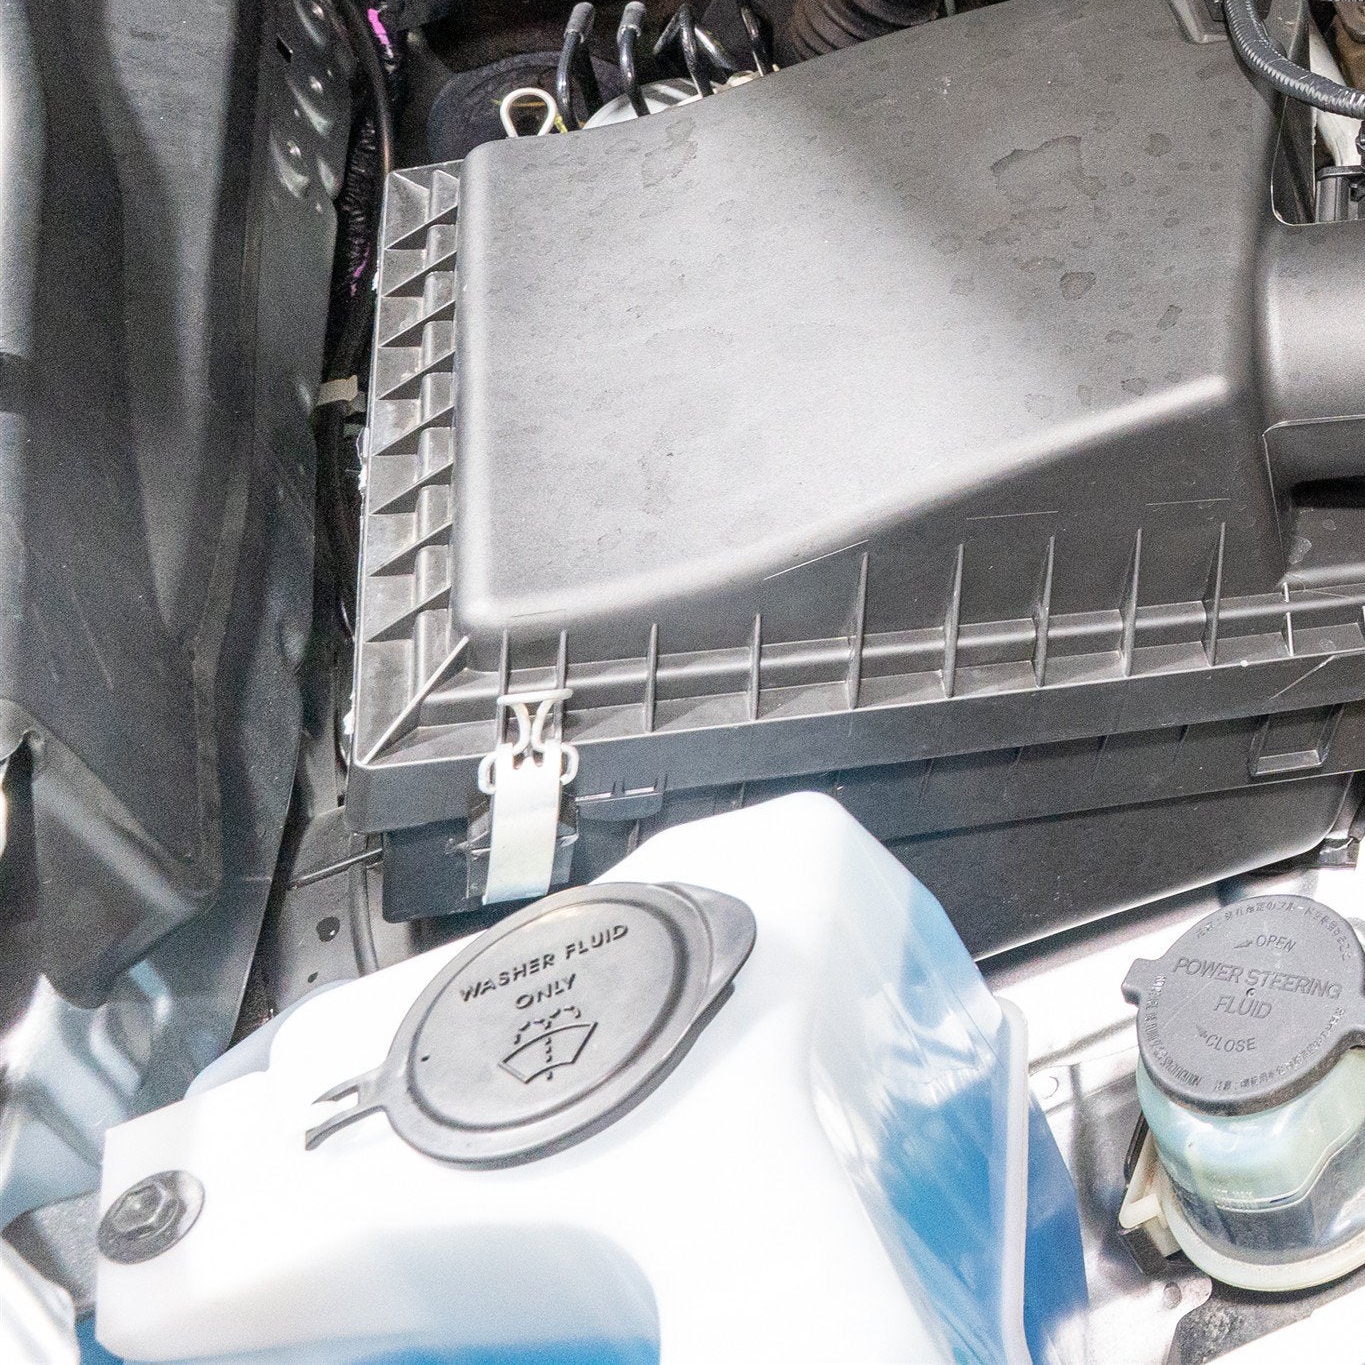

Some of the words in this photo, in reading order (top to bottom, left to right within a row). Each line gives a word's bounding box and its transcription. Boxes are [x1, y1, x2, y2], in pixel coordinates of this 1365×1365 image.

[1255, 934, 1297, 954] OPEN
[461, 954, 555, 1002] WASHER
[564, 924, 629, 960] FLUID
[1172, 956, 1244, 985] POWER
[1244, 968, 1343, 1000] STEERING
[515, 973, 577, 1010] ONLY
[1213, 995, 1273, 1020] FLUID
[1205, 1033, 1257, 1053] CLOSE
